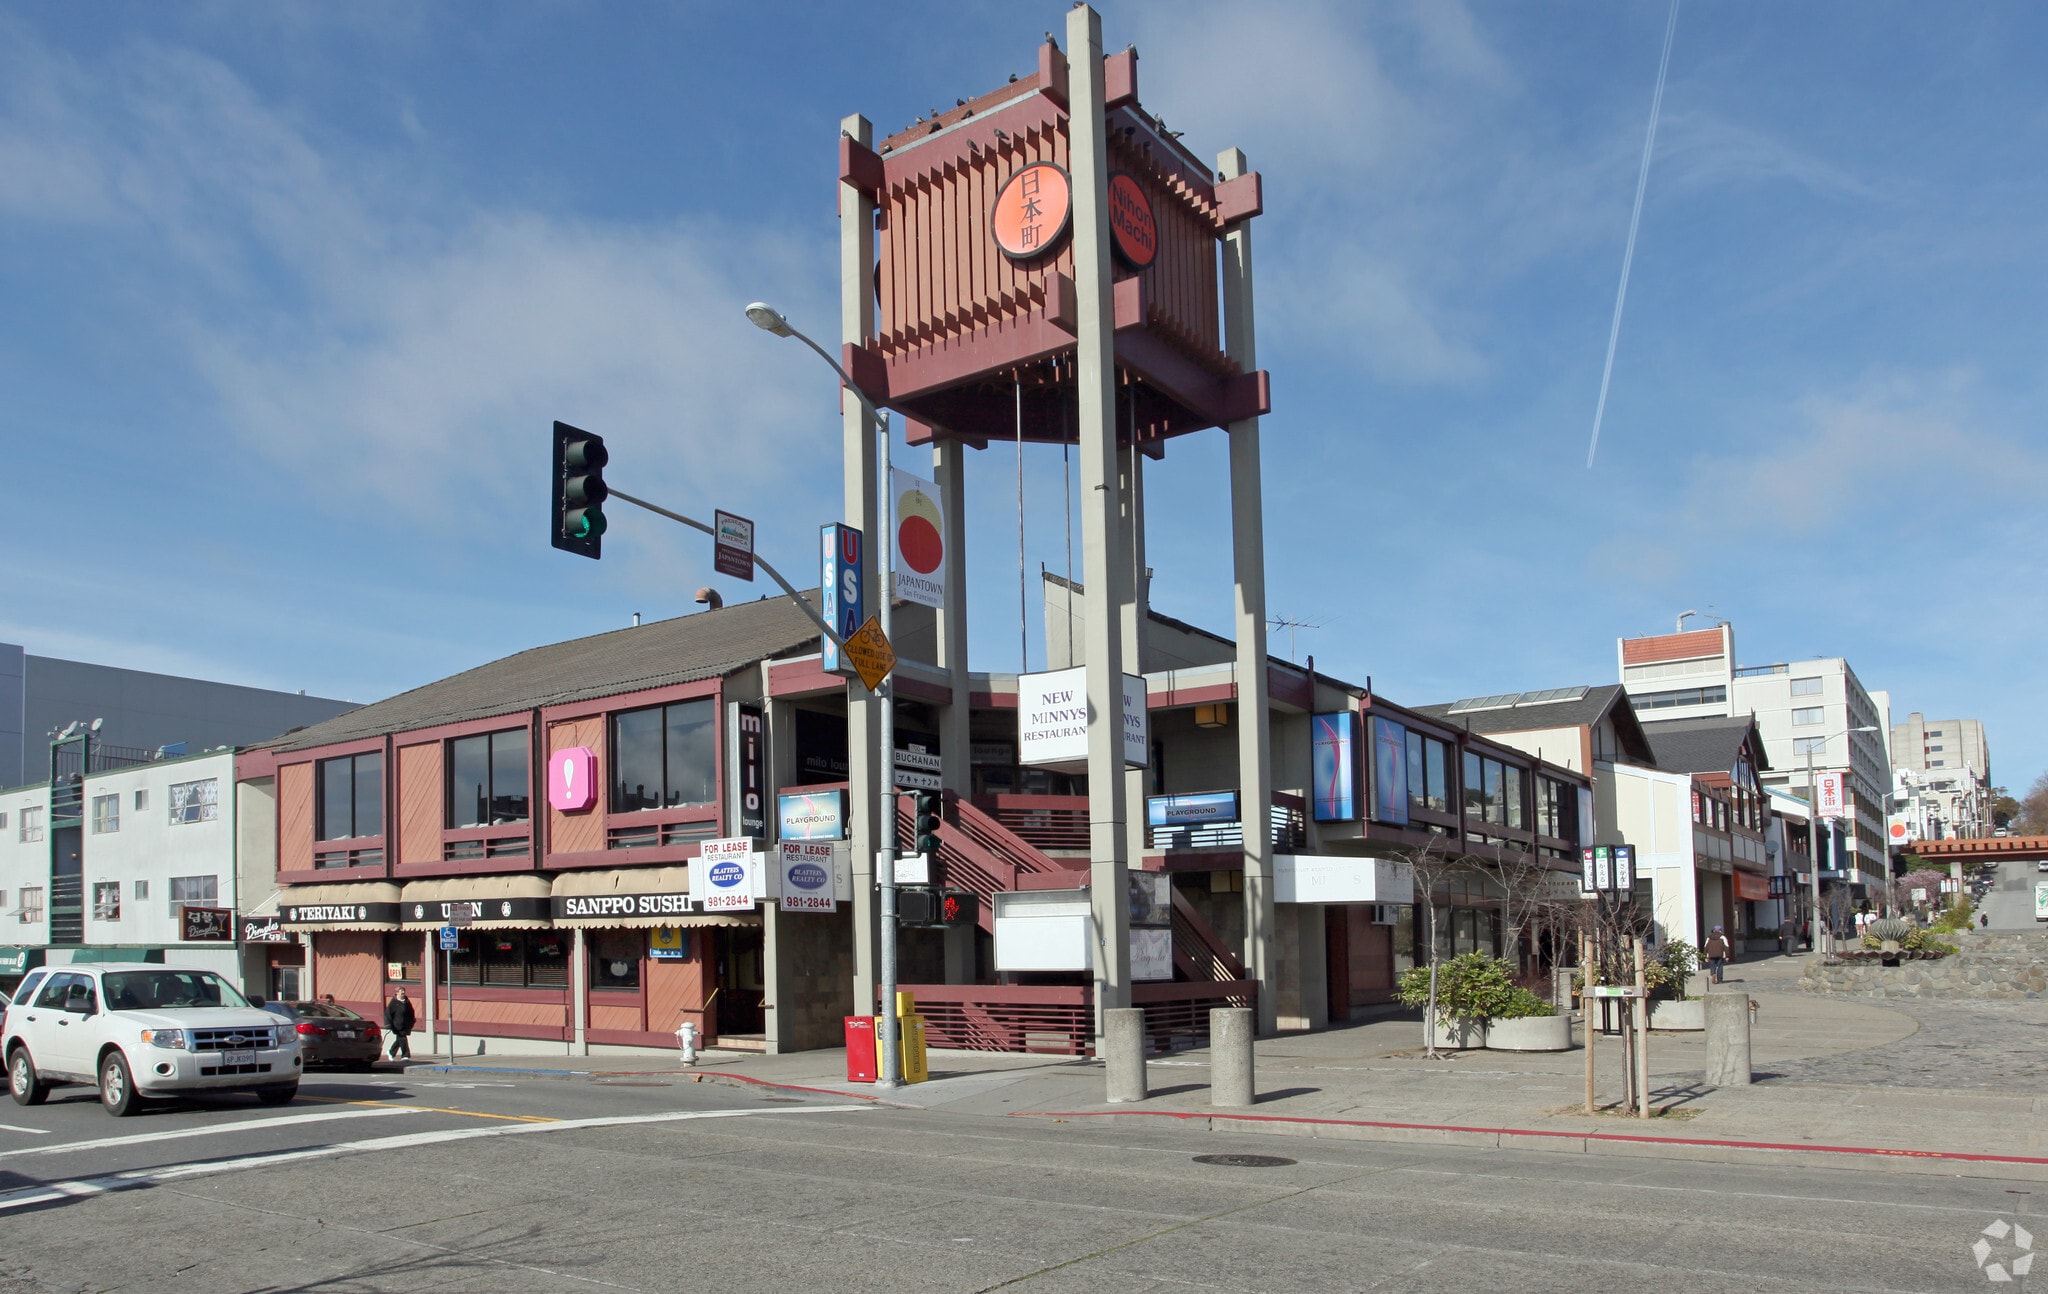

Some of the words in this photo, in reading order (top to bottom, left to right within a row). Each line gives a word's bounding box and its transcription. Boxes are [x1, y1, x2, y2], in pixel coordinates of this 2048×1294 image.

[1020, 168, 1043, 249] 日本町
[1113, 183, 1152, 228] Nihon
[1113, 207, 1152, 250] Machi
[721, 533, 748, 546] AMERICA
[824, 533, 834, 616] USA
[842, 528, 858, 640] USA
[898, 573, 943, 595] JAPANTOWN
[903, 588, 913, 598] San
[913, 590, 938, 603] Francisco
[848, 644, 874, 658] ALLOWED
[875, 650, 887, 661] USE
[855, 657, 869, 668] FULL
[872, 661, 886, 672] LANE
[1042, 690, 1073, 706] NEW
[1023, 725, 1087, 741] RESTAURAN
[741, 713, 761, 810] milo
[806, 756, 827, 768] milo
[895, 752, 940, 767] BUCHANAN
[786, 814, 836, 825] PLAYGROUND
[1166, 807, 1217, 817] PLAYGROUND
[742, 816, 763, 829] lounge
[704, 844, 719, 854] FOR
[722, 841, 748, 853] LEASE
[783, 844, 801, 854] FOR
[804, 845, 830, 856] LEASE
[707, 852, 745, 862] RESTAURANT
[786, 854, 827, 863] RESTAURANT
[711, 874, 732, 882] REALTY
[791, 875, 815, 883] REALTY
[441, 901, 482, 918] UN
[566, 896, 635, 915] SANPPO
[639, 894, 694, 913] SUSHI
[299, 905, 356, 921] TERIYAKI
[245, 917, 279, 940] Dimples
[389, 969, 401, 977] OPEN
